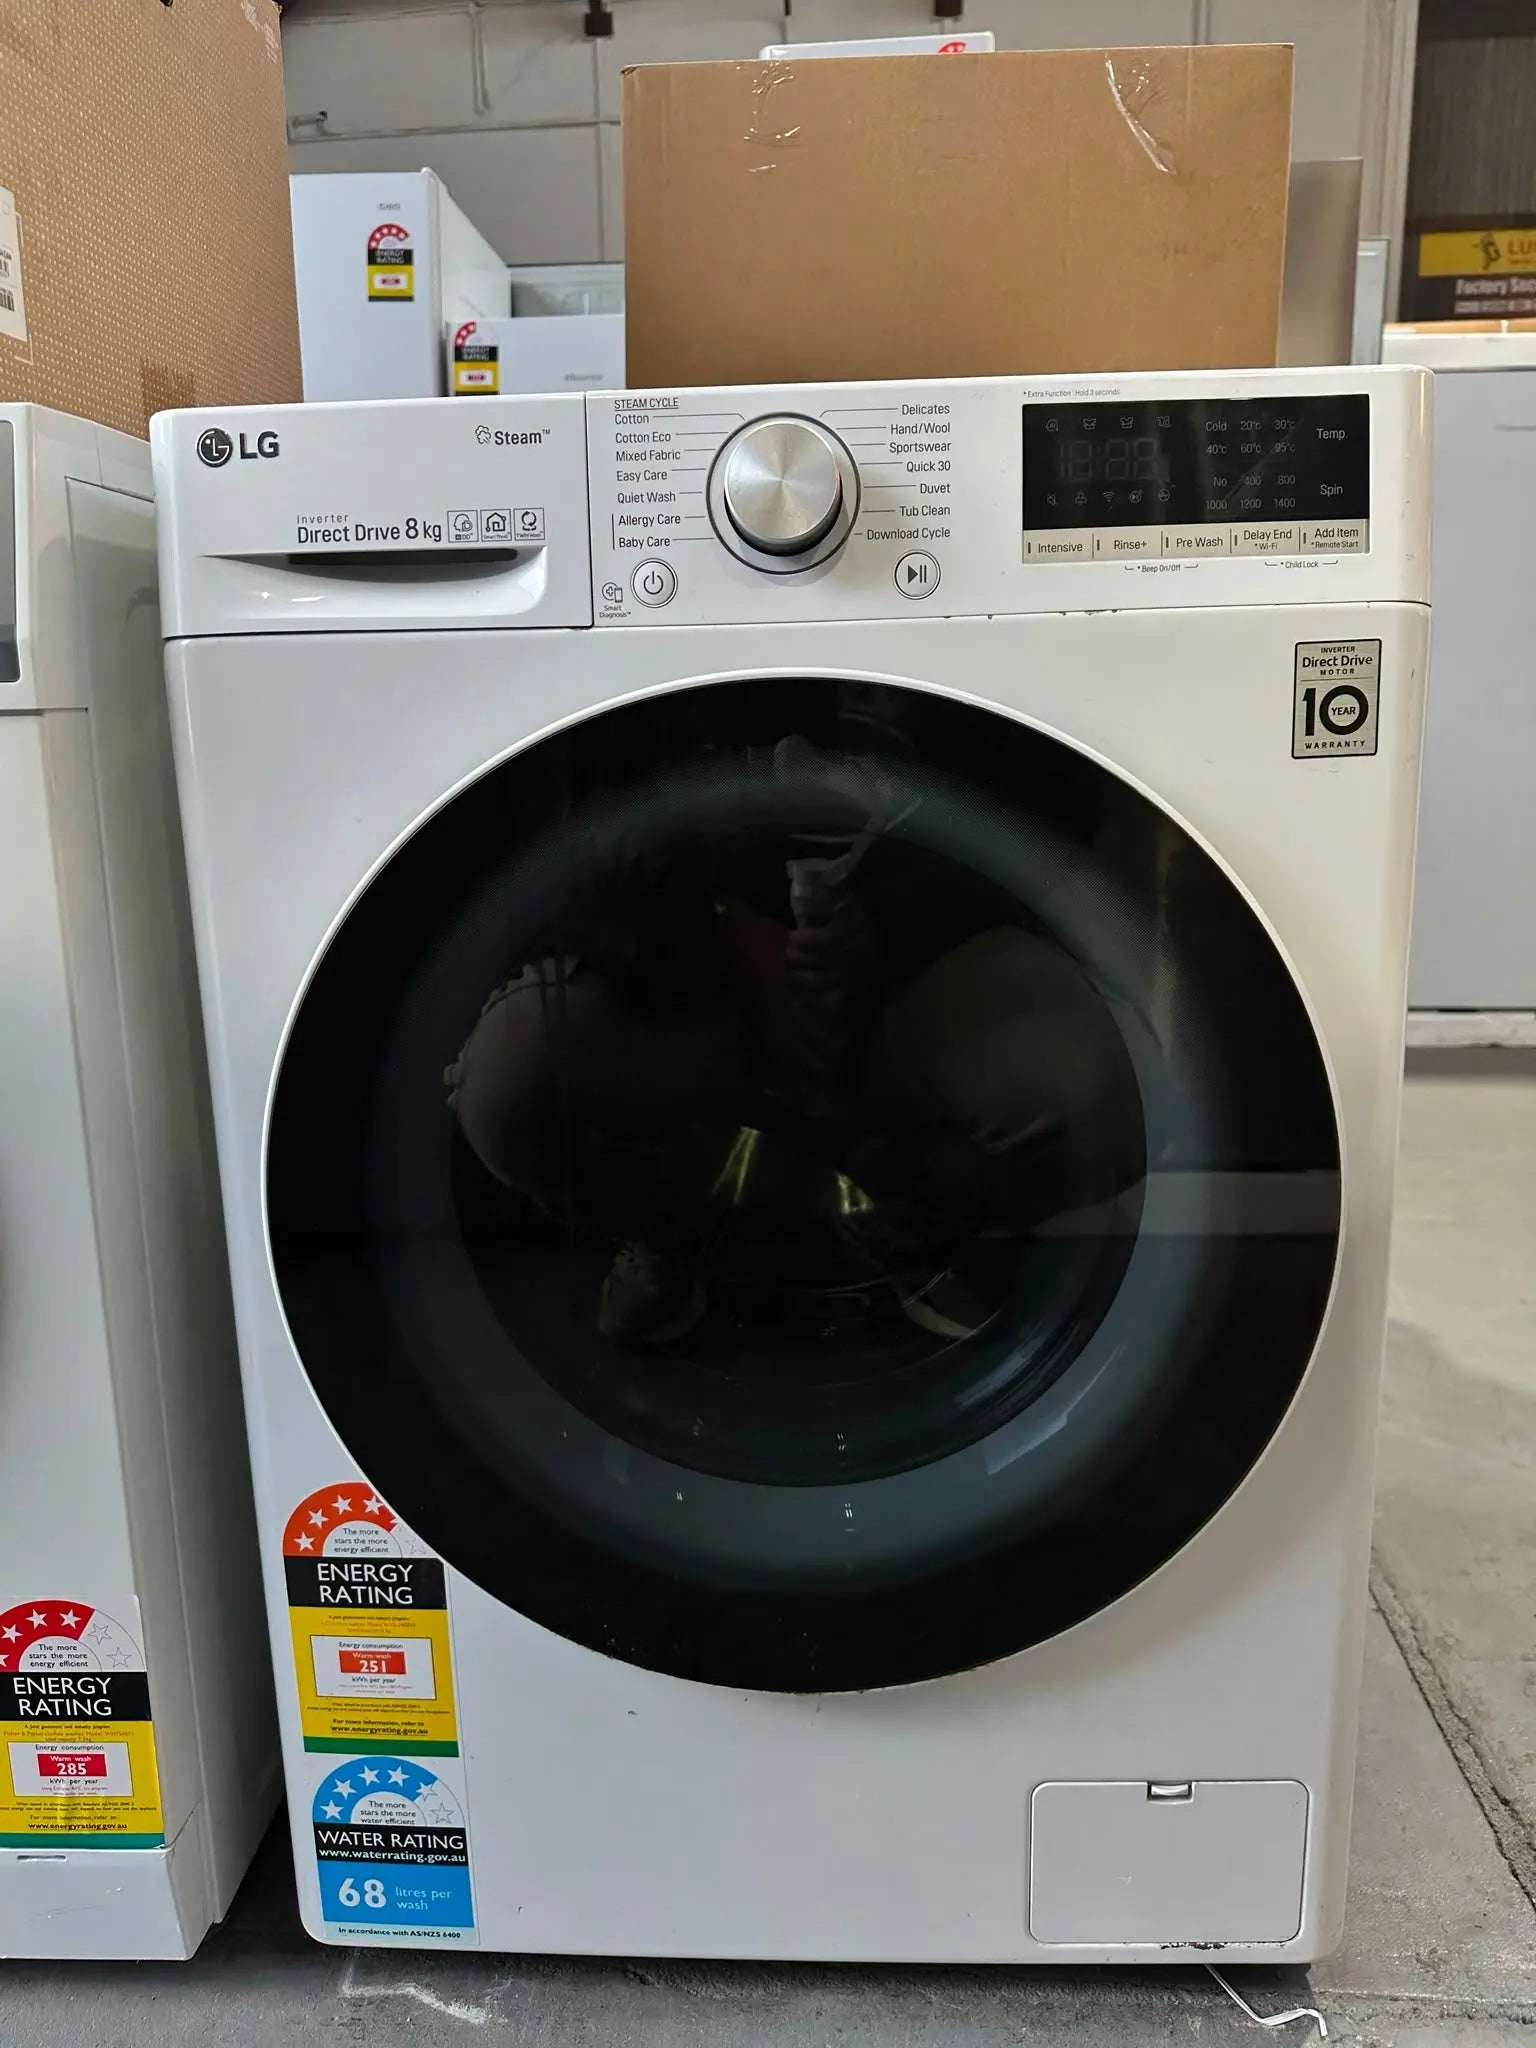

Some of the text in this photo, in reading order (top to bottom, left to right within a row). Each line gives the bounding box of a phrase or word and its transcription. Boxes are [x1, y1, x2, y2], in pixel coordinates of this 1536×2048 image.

[1028, 390, 1044, 398] Extra
[1095, 388, 1120, 396] seconds
[614, 398, 679, 410] STEAM CYCLE
[902, 403, 950, 416] Delicates
[614, 412, 650, 425] Cotton
[890, 422, 951, 436] Hand/Wool
[1206, 420, 1227, 432] Cold
[615, 431, 671, 444] Cotton Eco
[239, 431, 280, 459] LG
[889, 441, 952, 454] Sportswear
[616, 449, 680, 462] Mixed Fabric
[906, 460, 950, 473] Quick 30
[616, 469, 668, 484] Easy Care
[1214, 474, 1296, 488] No 400 800
[920, 482, 950, 494] Duvet
[1320, 484, 1343, 496] Spin
[618, 491, 676, 505] Quiet Wash
[1206, 498, 1296, 510] 1000 1200 1400
[899, 504, 950, 516] Tub Clean
[297, 513, 348, 524] Inverter
[618, 513, 681, 528] Allergy Care
[298, 518, 442, 543] Direct Drive 8 kg
[867, 527, 950, 542] Download Cycle
[1244, 528, 1292, 543] Delay End
[1315, 528, 1358, 539] Add Item
[618, 536, 670, 550] Baby Care
[1038, 542, 1083, 553] Intensive
[1114, 538, 1148, 550] Rinse+
[1176, 536, 1224, 548] Pre Wash
[1315, 539, 1358, 549] Remote Start
[1142, 564, 1158, 574] Beep
[1285, 560, 1319, 568] Child Lock
[1321, 646, 1355, 654] INVERTER
[1302, 655, 1373, 668] Direct Drive
[1320, 668, 1355, 676] MOTOR
[1302, 685, 1368, 736] 10
[1332, 706, 1356, 716] YEAR
[1305, 740, 1366, 750] WARRANTY
[317, 1562, 414, 1582] ENERGY
[320, 1585, 413, 1604] RATING
[362, 1642, 403, 1650] consumption
[360, 1660, 387, 1672] 251
[13, 1677, 112, 1694] ENERGY
[18, 1699, 112, 1716] RATING
[330, 1726, 428, 1736] www.energyrating.gov.au
[56, 1763, 87, 1775] 285
[368, 1800, 384, 1808] The
[28, 1822, 128, 1831] www.energyrating.gov.au
[318, 1830, 464, 1850] WATER RATING
[318, 1849, 466, 1864] www.waterrating.gov.au
[338, 1878, 386, 1908] 68
[396, 1886, 452, 1900] litres per
[396, 1900, 428, 1910] wash
